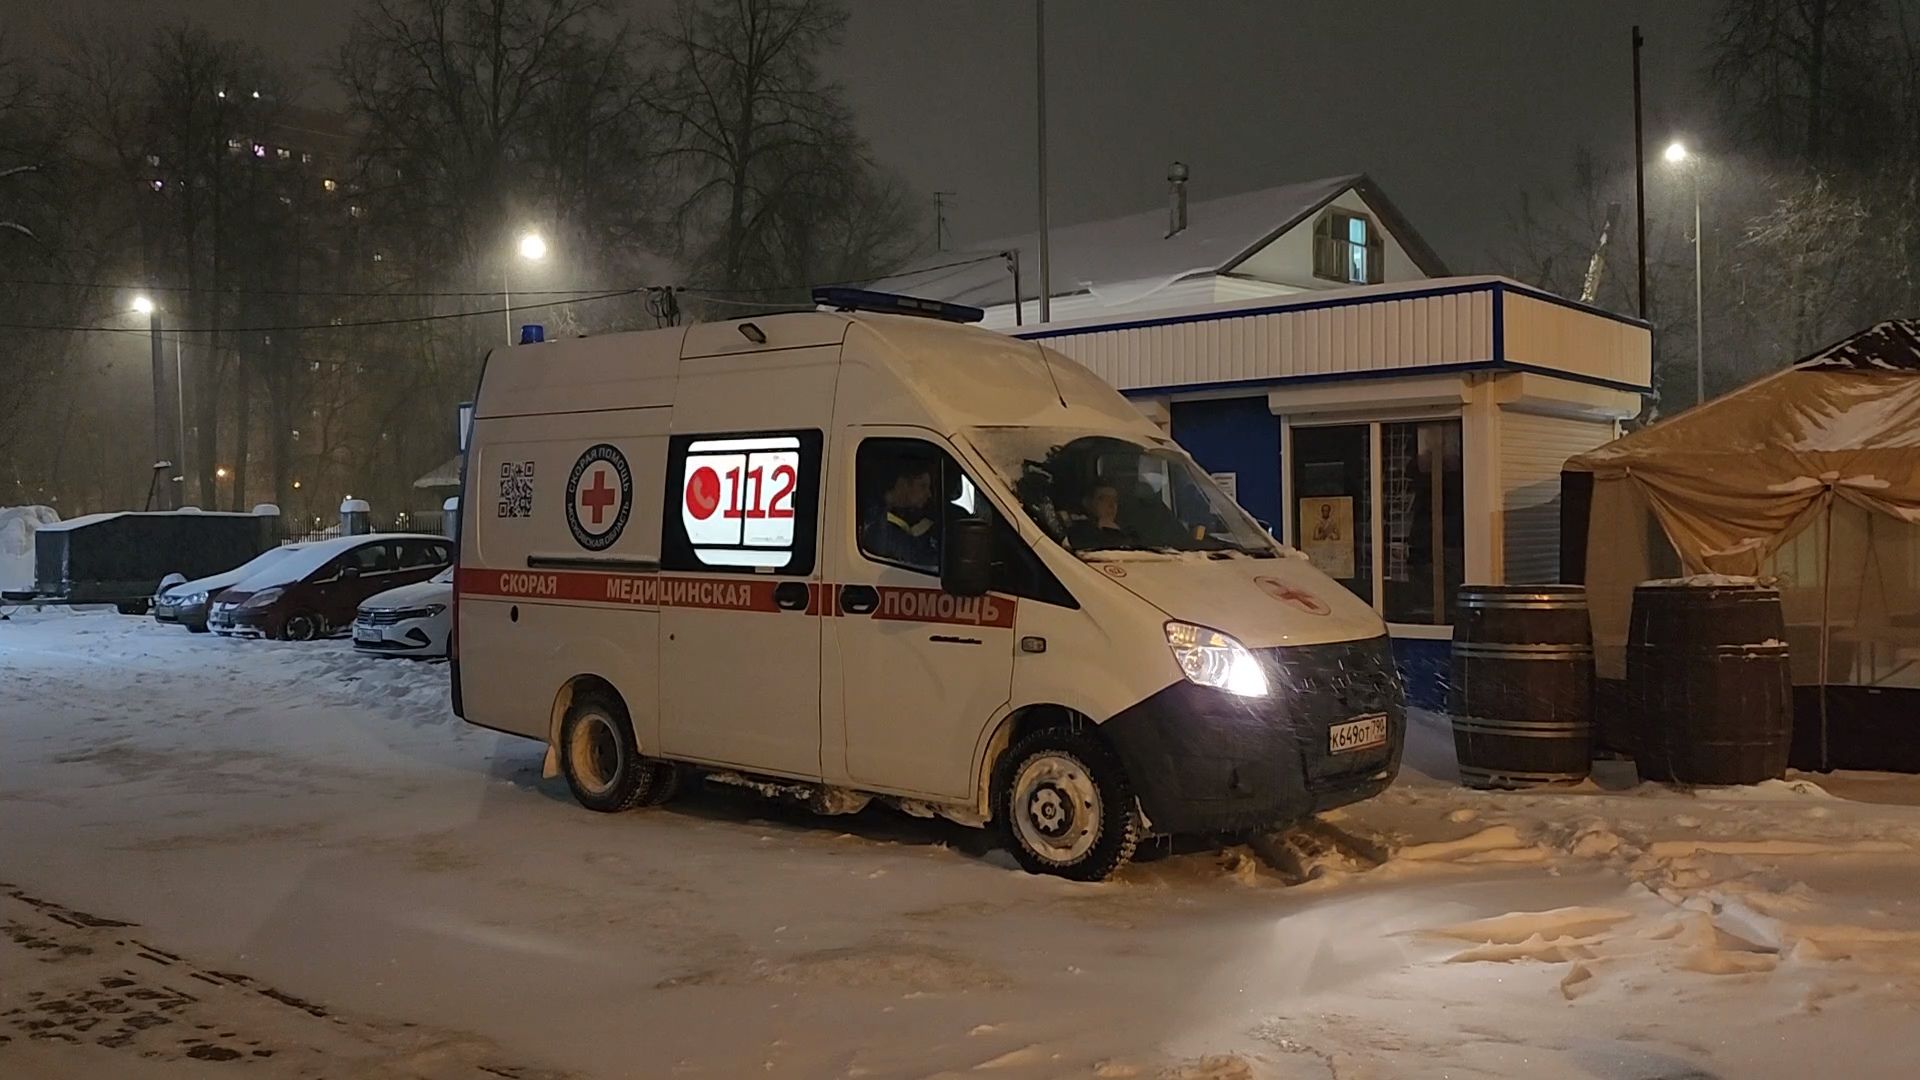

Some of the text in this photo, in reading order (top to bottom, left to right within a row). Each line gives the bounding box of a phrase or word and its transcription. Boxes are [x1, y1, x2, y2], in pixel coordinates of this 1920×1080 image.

[568, 447, 631, 494] СКОРАЯ ПОМОЩЬ
[723, 464, 796, 518] 112
[500, 573, 1000, 625] СКОРАЯ МЕДИЦИНСКАЯ ПОМОЩЬ
[1332, 725, 1370, 749] К649ОТ
